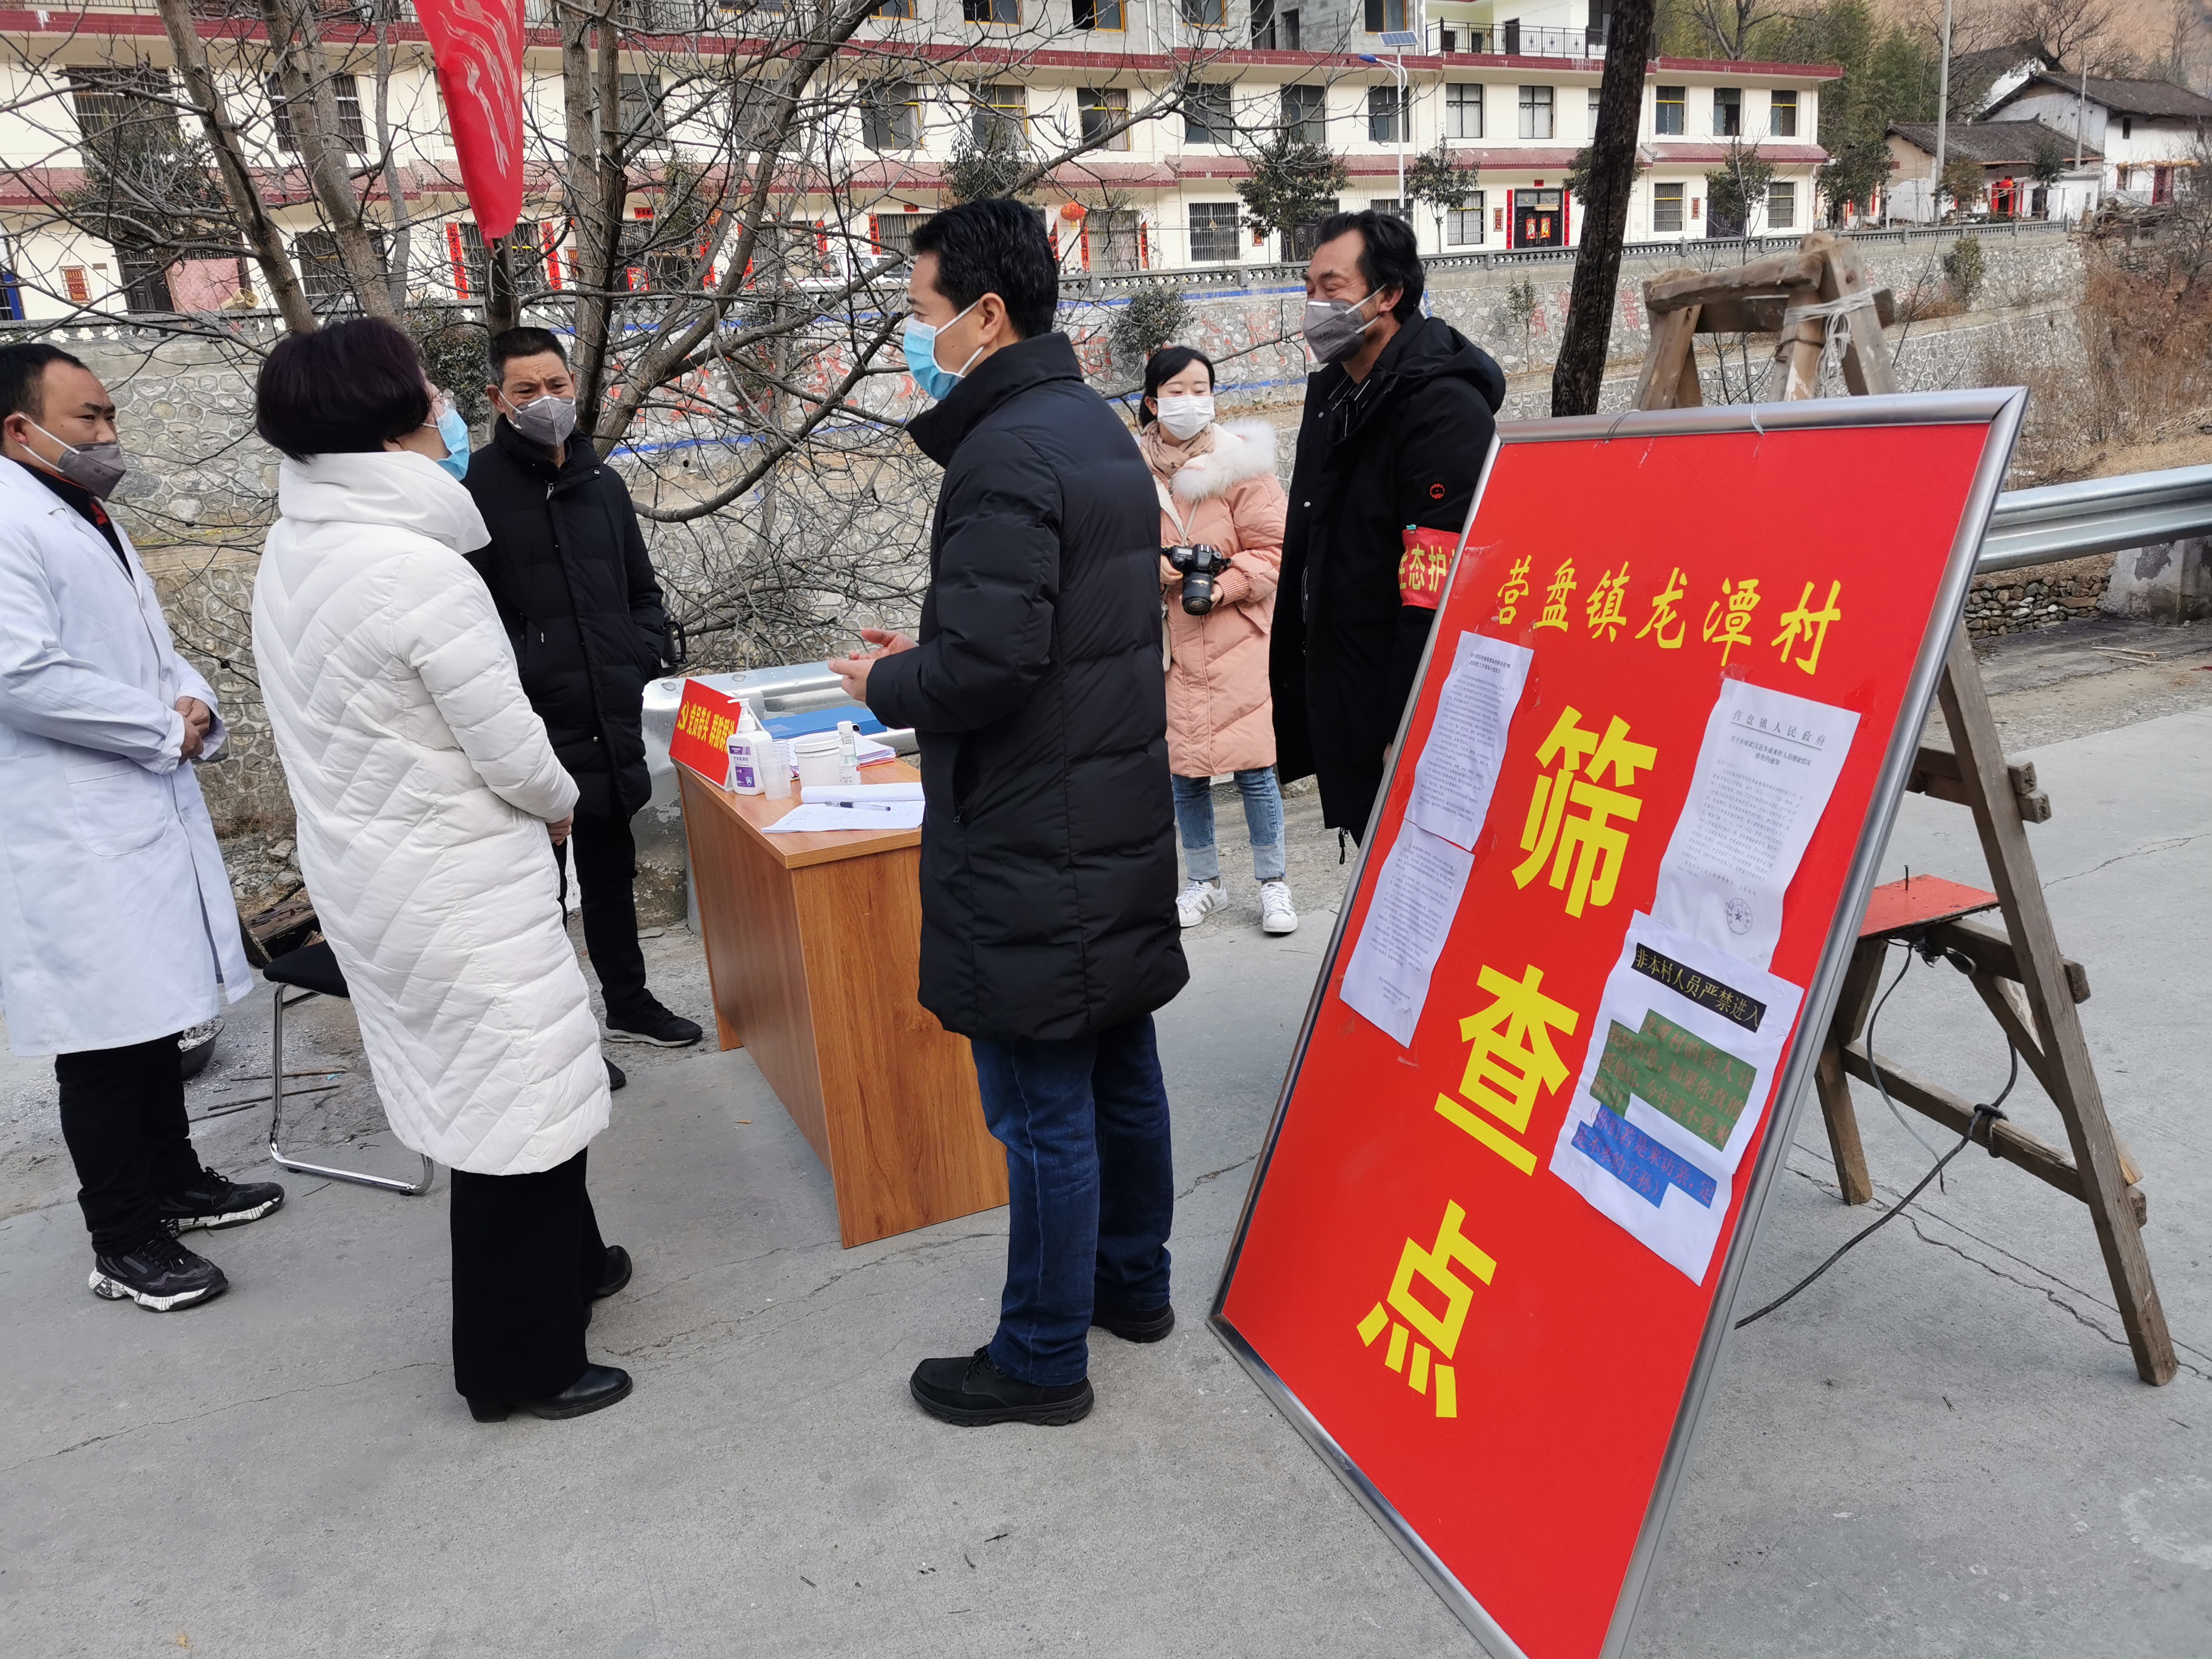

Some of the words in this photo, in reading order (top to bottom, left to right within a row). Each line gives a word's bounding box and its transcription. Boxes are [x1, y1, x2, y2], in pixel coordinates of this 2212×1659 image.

[1498, 556, 1840, 674] 营盘镇龙潭村
[686, 703, 711, 742] 党员带头
[1732, 709, 1826, 746] 营盘镇人民政府
[1635, 948, 1759, 1028] 非本村人员严禁进入
[1357, 706, 1657, 1418] 筛查点
